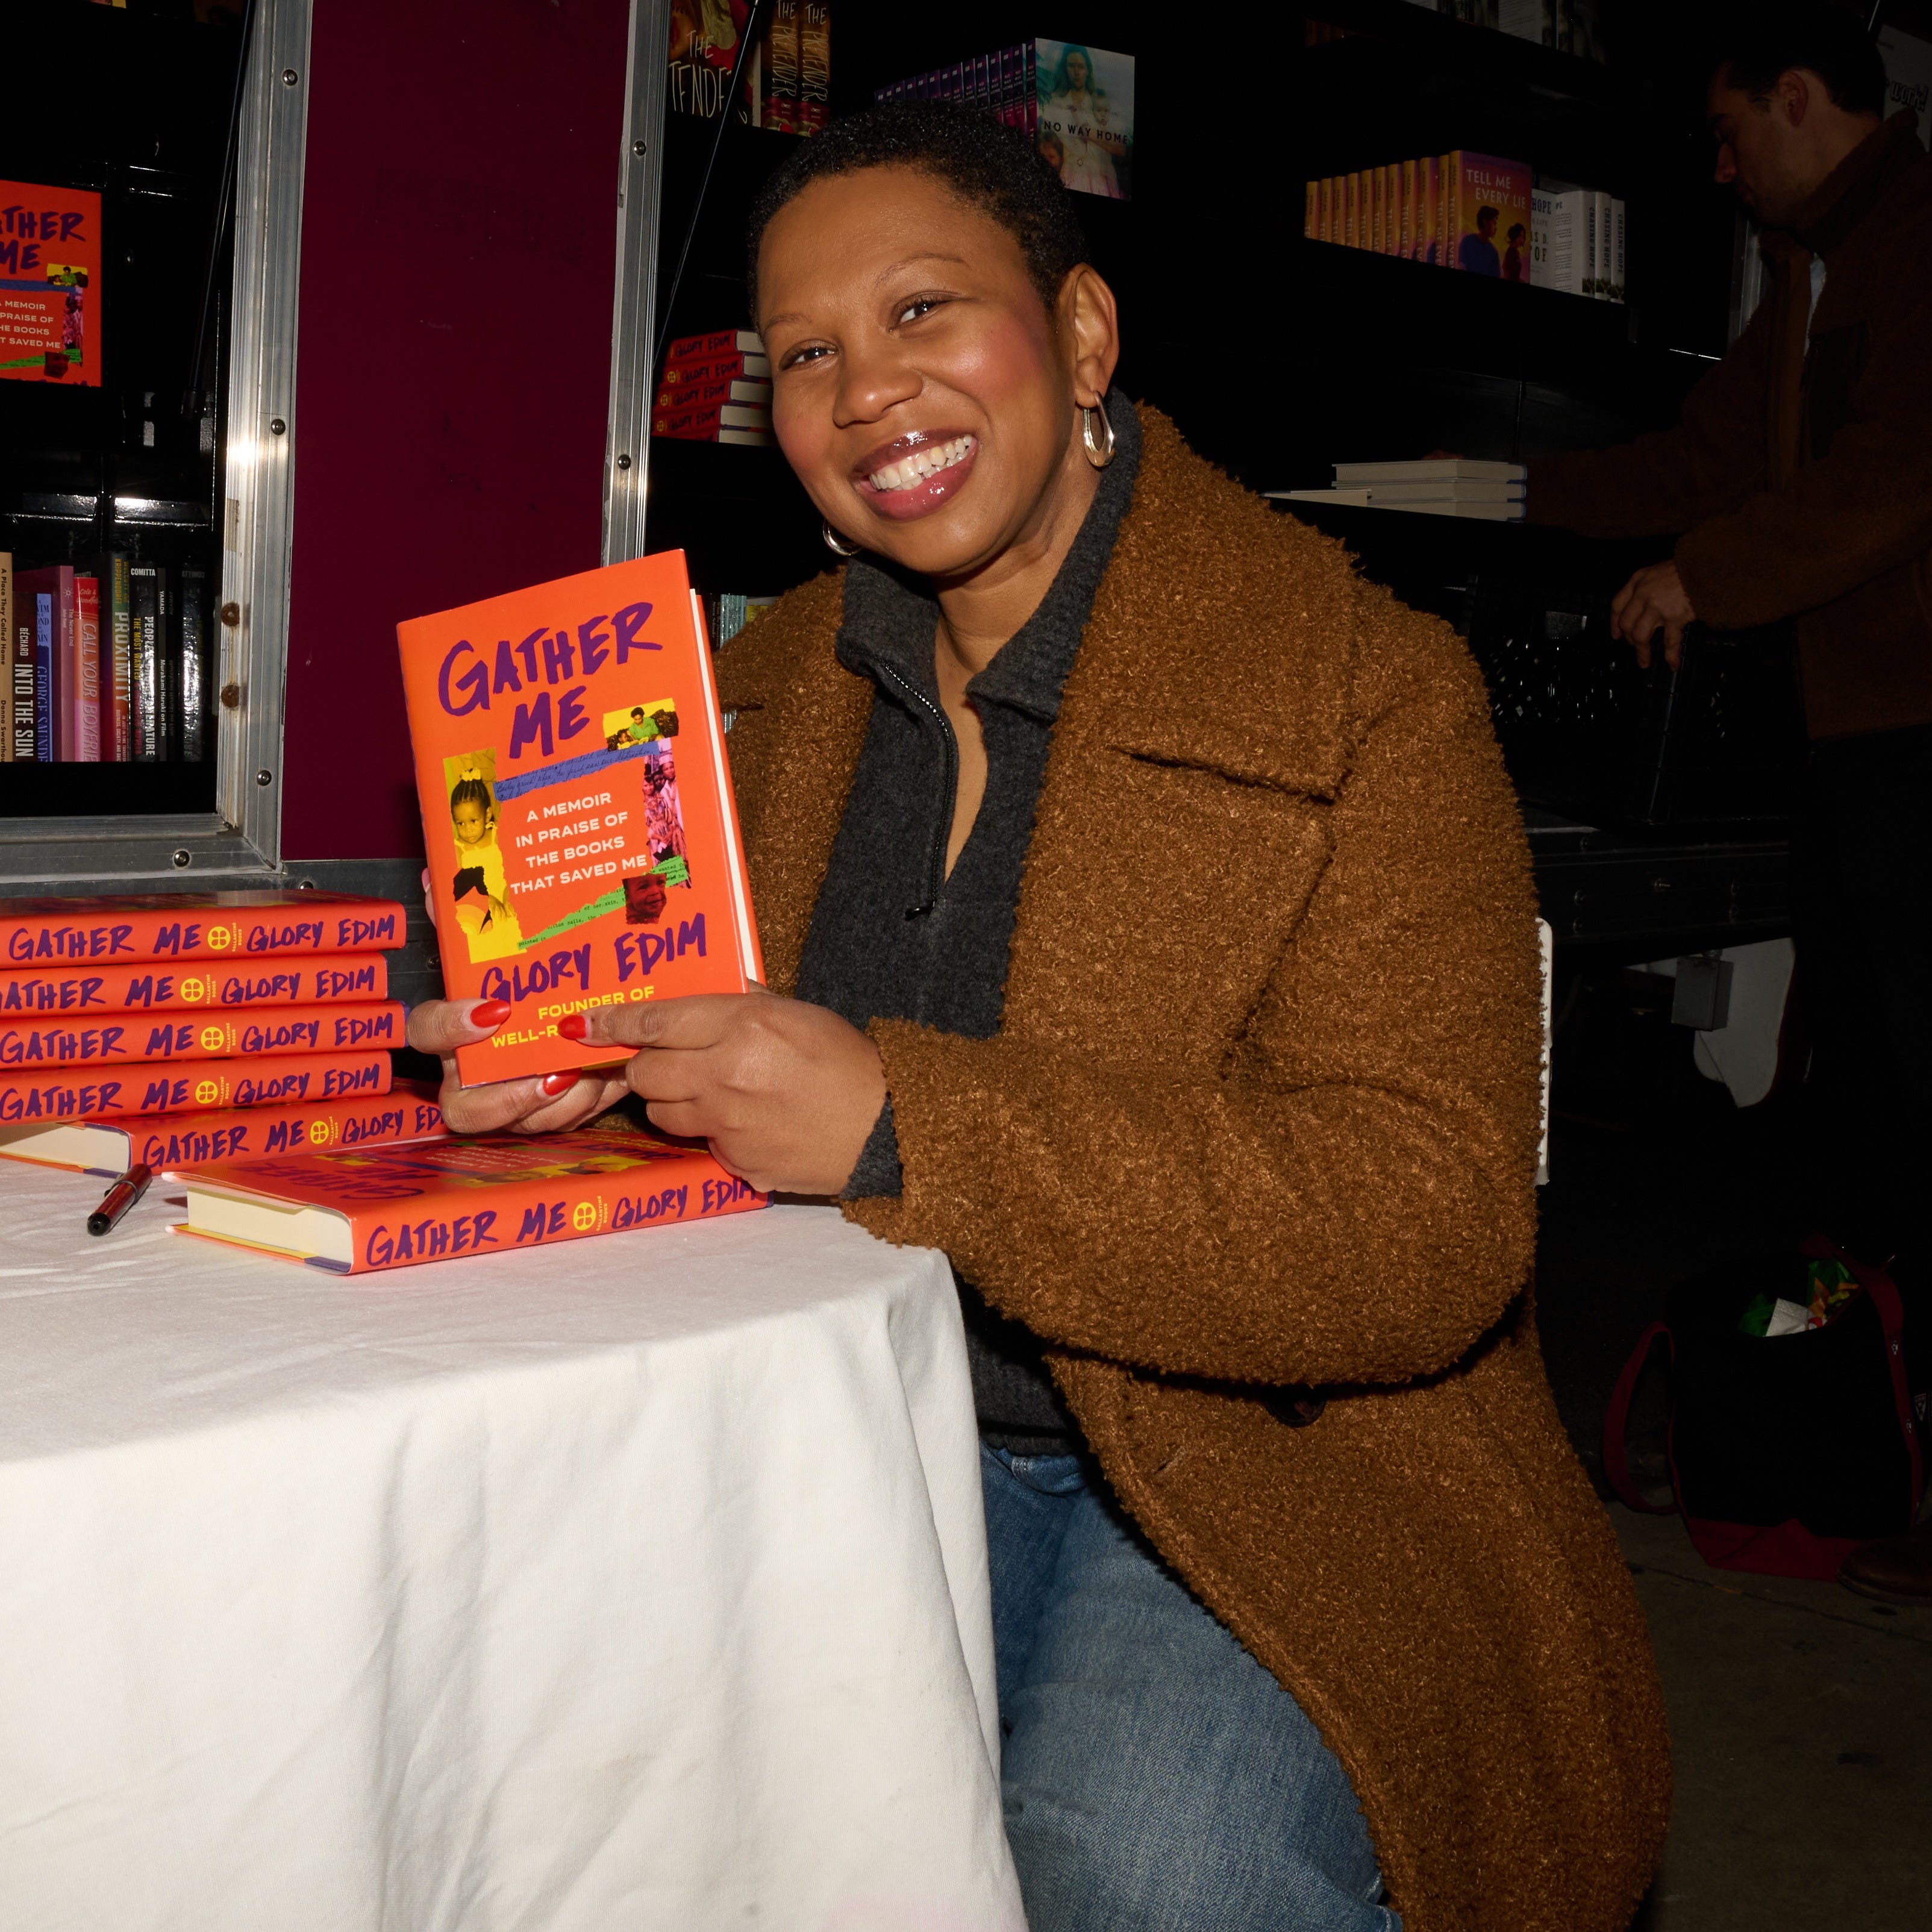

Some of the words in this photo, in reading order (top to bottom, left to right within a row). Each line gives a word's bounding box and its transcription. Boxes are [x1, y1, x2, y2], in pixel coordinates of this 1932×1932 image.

[777, 0, 796, 20] THE
[805, 4, 827, 25] THE
[687, 30, 714, 59] THE
[771, 25, 798, 98] PRETENDER
[801, 31, 828, 102] PRETENDER
[668, 61, 733, 118] TENDE
[1043, 122, 1062, 132] NO
[1068, 124, 1091, 137] WAY
[1096, 130, 1129, 144] HOME
[1466, 169, 1492, 186] TELL
[1495, 175, 1512, 190] ME
[1476, 187, 1509, 205] EVERY
[1513, 195, 1527, 209] LIE
[0, 205, 86, 242] THER
[1532, 198, 1551, 214] HOPE
[0, 312, 37, 322] PRAISE
[5, 301, 46, 310] MEMOIR
[9, 338, 43, 347] SAVED
[14, 327, 49, 335] BOOKS
[131, 568, 156, 577] COMITTA
[19, 628, 30, 656] BÉCHARD
[82, 624, 96, 657] CALL
[114, 612, 129, 702] PROXIMITY
[438, 602, 663, 716] GATHER
[15, 664, 33, 694] INTO
[37, 666, 48, 711] GEORGE
[83, 661, 97, 698] YOUR
[15, 700, 33, 724] THE
[509, 686, 590, 760] ME
[16, 730, 34, 757] SUN
[37, 717, 48, 762] SAUNDE
[83, 705, 98, 762] BOYFRIE
[527, 810, 539, 823] A
[543, 792, 612, 819] MEMOIR
[516, 834, 533, 848] IN
[538, 818, 601, 843] PRAISE
[604, 811, 628, 827] OF
[525, 852, 560, 869] THE
[564, 836, 625, 861] BOOKS
[510, 878, 554, 896] THAT
[560, 863, 618, 886] SAVED
[622, 854, 648, 871] ME
[9, 925, 135, 960] GATHER
[153, 924, 201, 954] ME
[246, 922, 323, 952] GLORY
[338, 914, 395, 946] EDIM
[481, 943, 590, 1004] GLORY
[614, 913, 707, 982] EDIM
[0, 978, 105, 1010] ATHER
[125, 976, 174, 1007] ME
[222, 972, 301, 1004] GLORY
[316, 966, 375, 998] EDIM
[538, 992, 625, 1020] FOUNDER
[630, 986, 654, 1002] OF
[1, 1027, 125, 1063] GATHER
[146, 1025, 194, 1055] ME
[241, 1020, 319, 1052] GLORY
[334, 1013, 393, 1046] EDIM
[491, 1024, 558, 1049] WELL-R
[1, 1082, 123, 1121] GATHER
[140, 1079, 189, 1110] ME
[233, 1072, 310, 1104] GLORY
[324, 1063, 380, 1095] EDIM
[342, 1109, 404, 1143] GLORY
[414, 1105, 444, 1133] ED
[143, 1125, 250, 1168] GATHER
[264, 1121, 304, 1151] ME
[611, 1186, 688, 1228] GLORY
[366, 1208, 498, 1266] GATHER
[515, 1201, 566, 1242] ME
